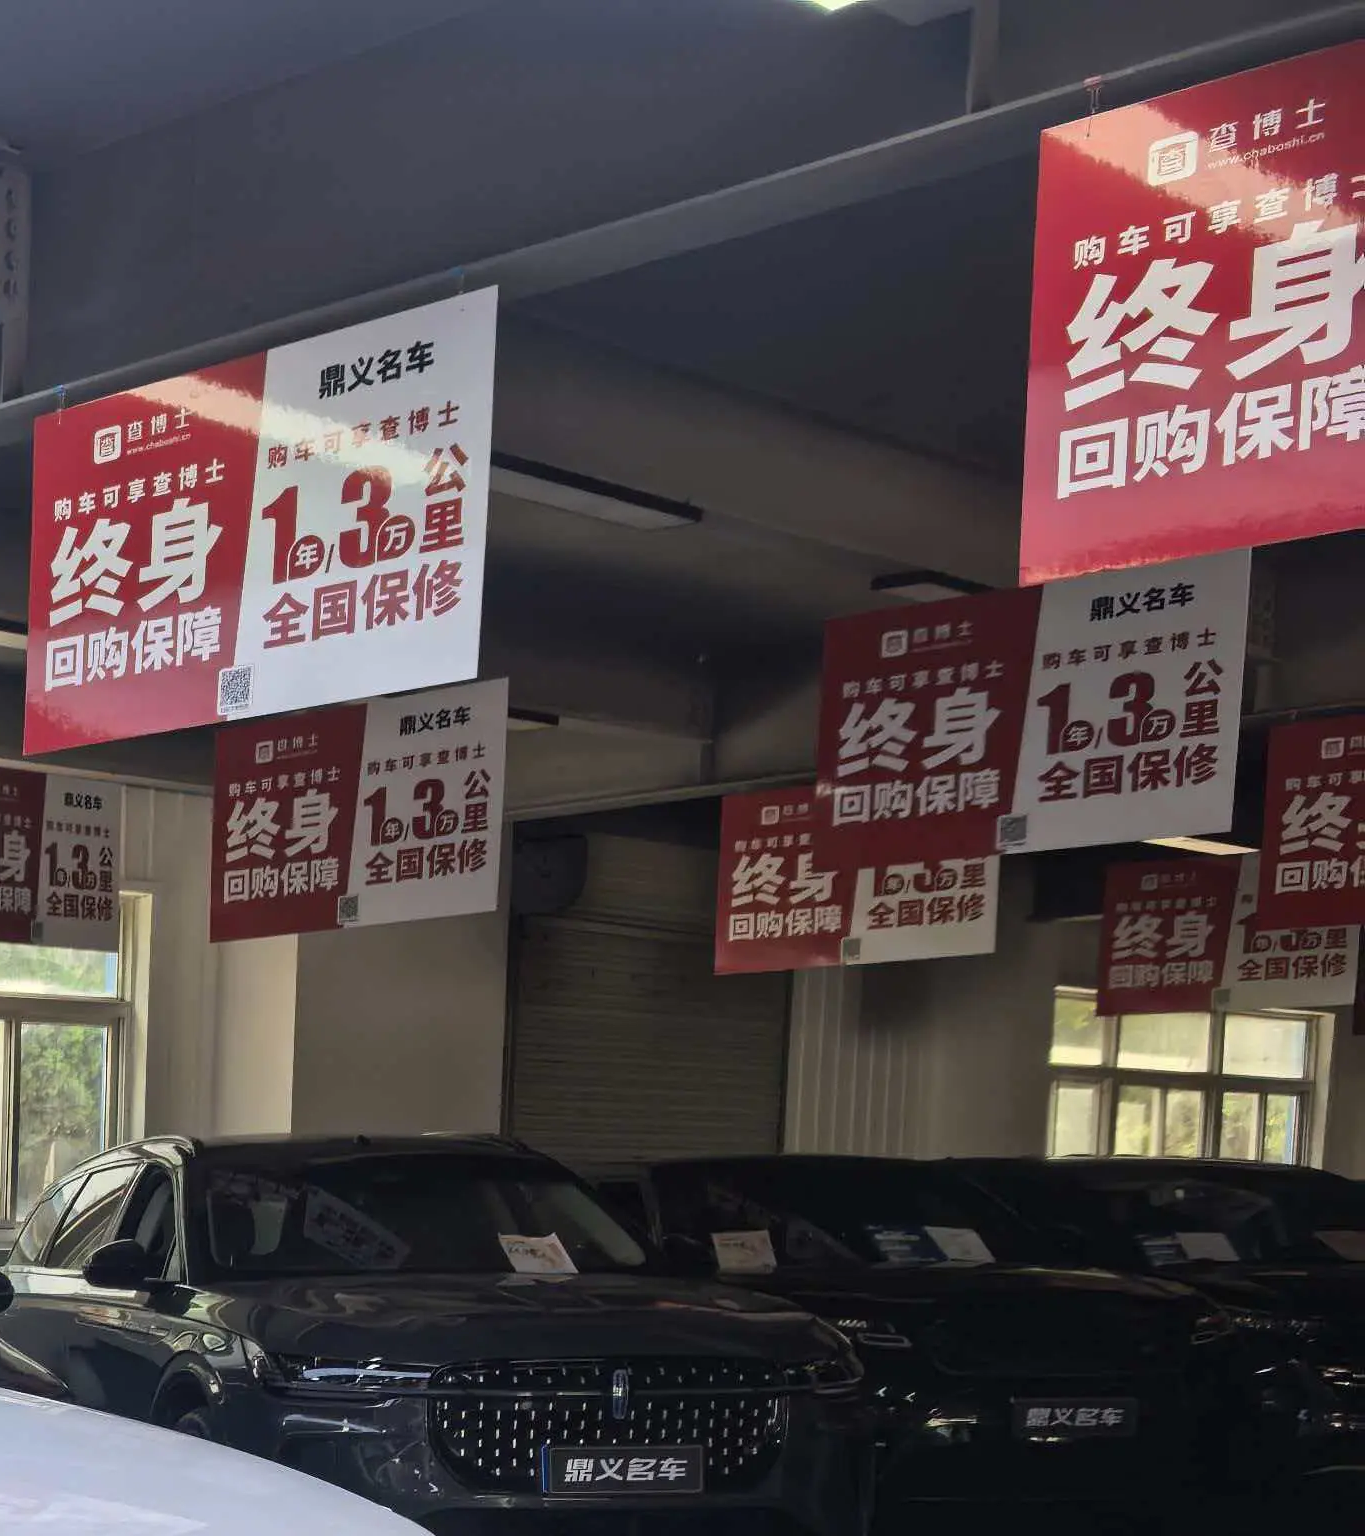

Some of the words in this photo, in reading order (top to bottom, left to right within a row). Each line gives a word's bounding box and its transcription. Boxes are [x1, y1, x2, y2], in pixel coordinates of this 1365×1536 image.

[1207, 131, 1325, 170] www.chaboshi.cn
[1208, 97, 1326, 152] 查博士
[1064, 218, 1365, 411] 终身
[319, 341, 434, 399] 鼎义名车
[127, 407, 192, 443] 查博士
[268, 401, 460, 469] 购车可享查博士
[1057, 364, 1365, 499] 回购保障
[54, 458, 225, 521] 购车可享查博士
[49, 498, 223, 627] 终身
[262, 560, 463, 650] 全国保修
[1090, 583, 1195, 622] 鼎义名车
[45, 606, 221, 692] 回购保障
[1042, 627, 1217, 670] 购车可享查博士
[400, 706, 471, 736] 鼎义名车
[836, 686, 1003, 778] 终身
[228, 766, 341, 798] 购车可享查博士
[832, 768, 1001, 826] 回购保障
[1037, 743, 1218, 802] 全国保修
[225, 788, 338, 863] 终身
[1279, 792, 1365, 855] 终
[223, 855, 339, 904] 回购保障
[365, 839, 487, 886] 全国保修
[47, 892, 113, 921] 全国保修
[728, 904, 842, 942] 回购保障
[866, 894, 985, 931] 全国保修
[1111, 911, 1215, 961] 终身
[1237, 953, 1347, 981] 全国保修
[564, 1458, 688, 1482] 鼎义名车
